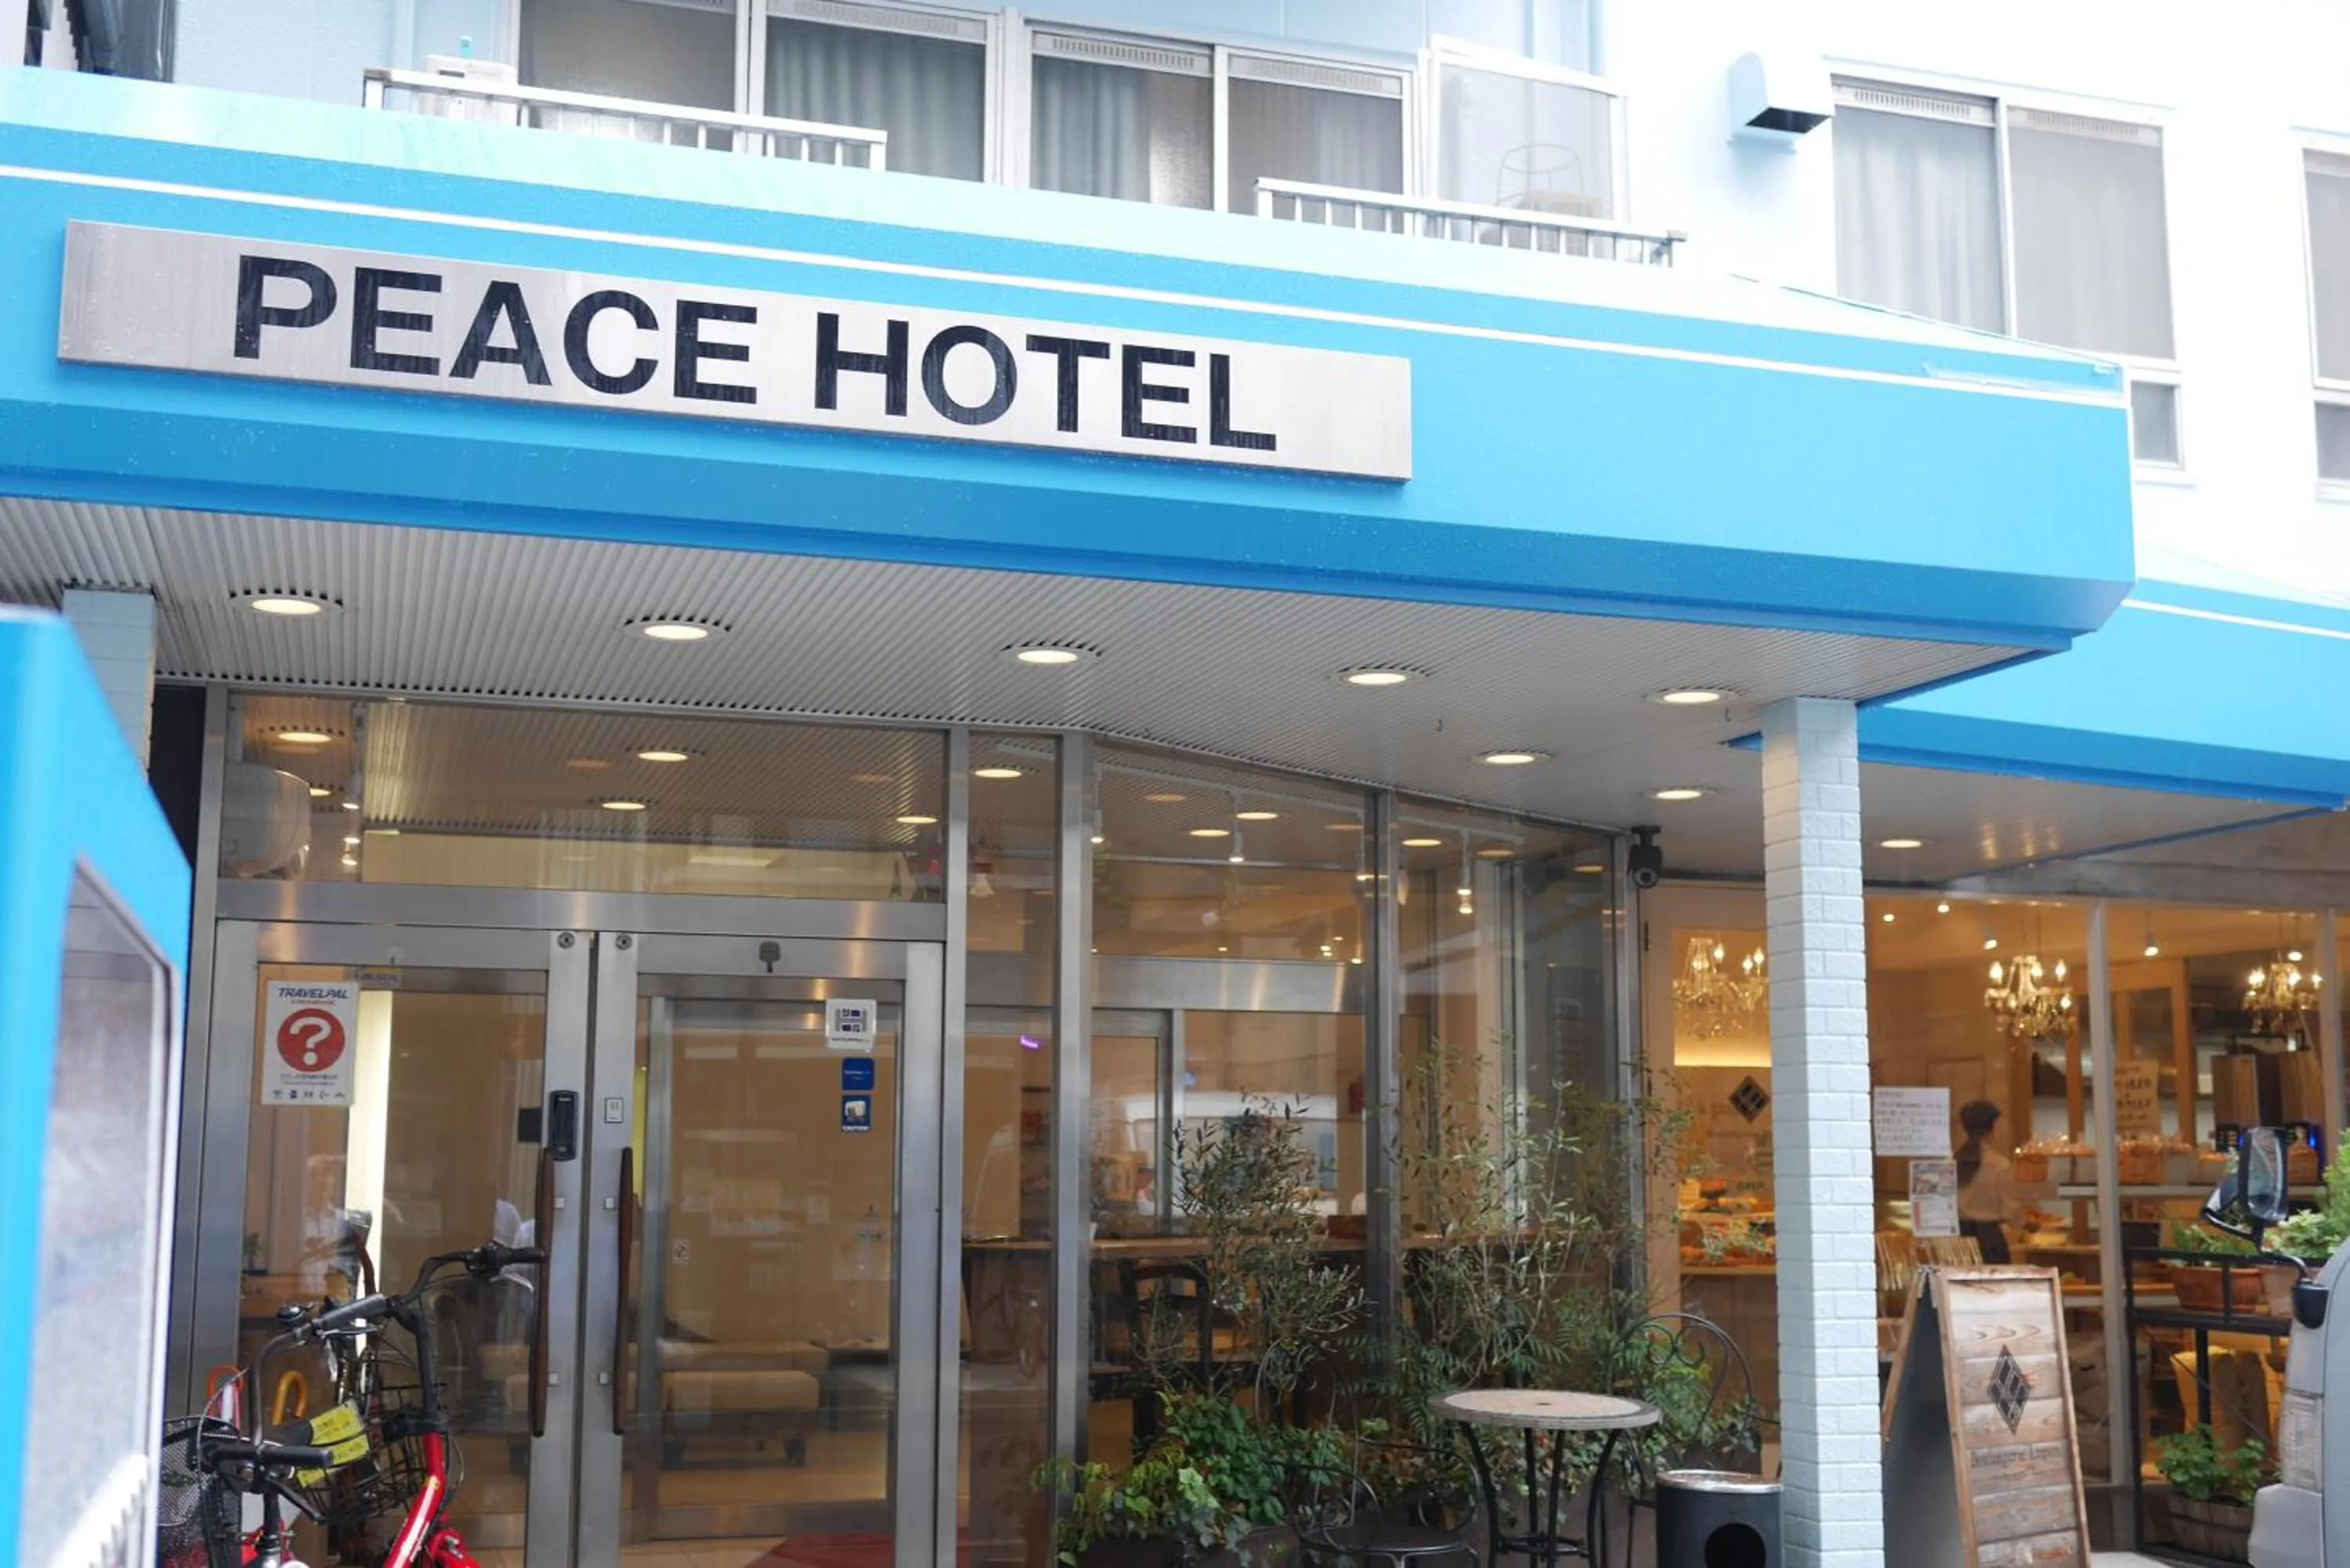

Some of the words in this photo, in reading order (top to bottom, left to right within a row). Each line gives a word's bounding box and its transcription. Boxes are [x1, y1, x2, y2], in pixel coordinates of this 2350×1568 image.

[233, 255, 757, 404] PEACE
[814, 312, 1277, 451] HOTEL
[277, 988, 349, 999] TRAVELPAL
